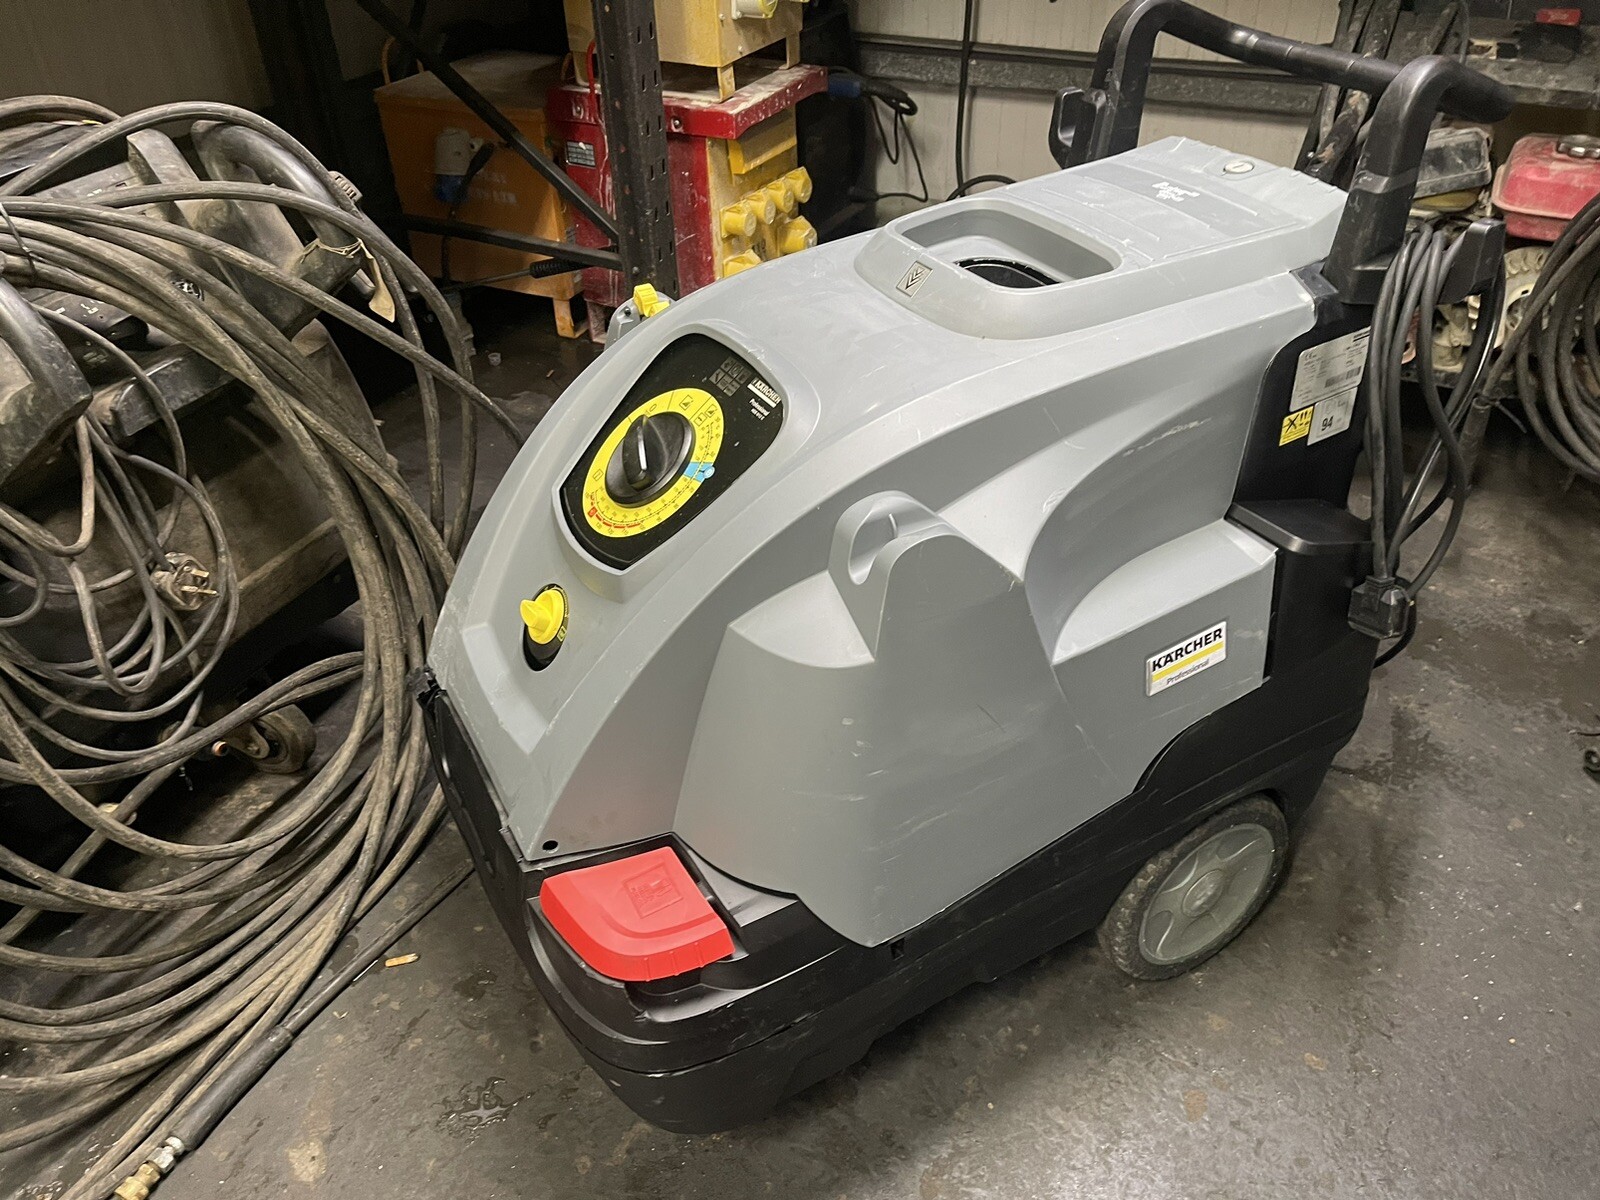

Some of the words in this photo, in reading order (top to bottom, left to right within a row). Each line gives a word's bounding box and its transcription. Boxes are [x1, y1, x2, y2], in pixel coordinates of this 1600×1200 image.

[1321, 416, 1334, 431] 94
[1152, 628, 1223, 672] KÄRCHER
[1166, 658, 1210, 685] Professional
